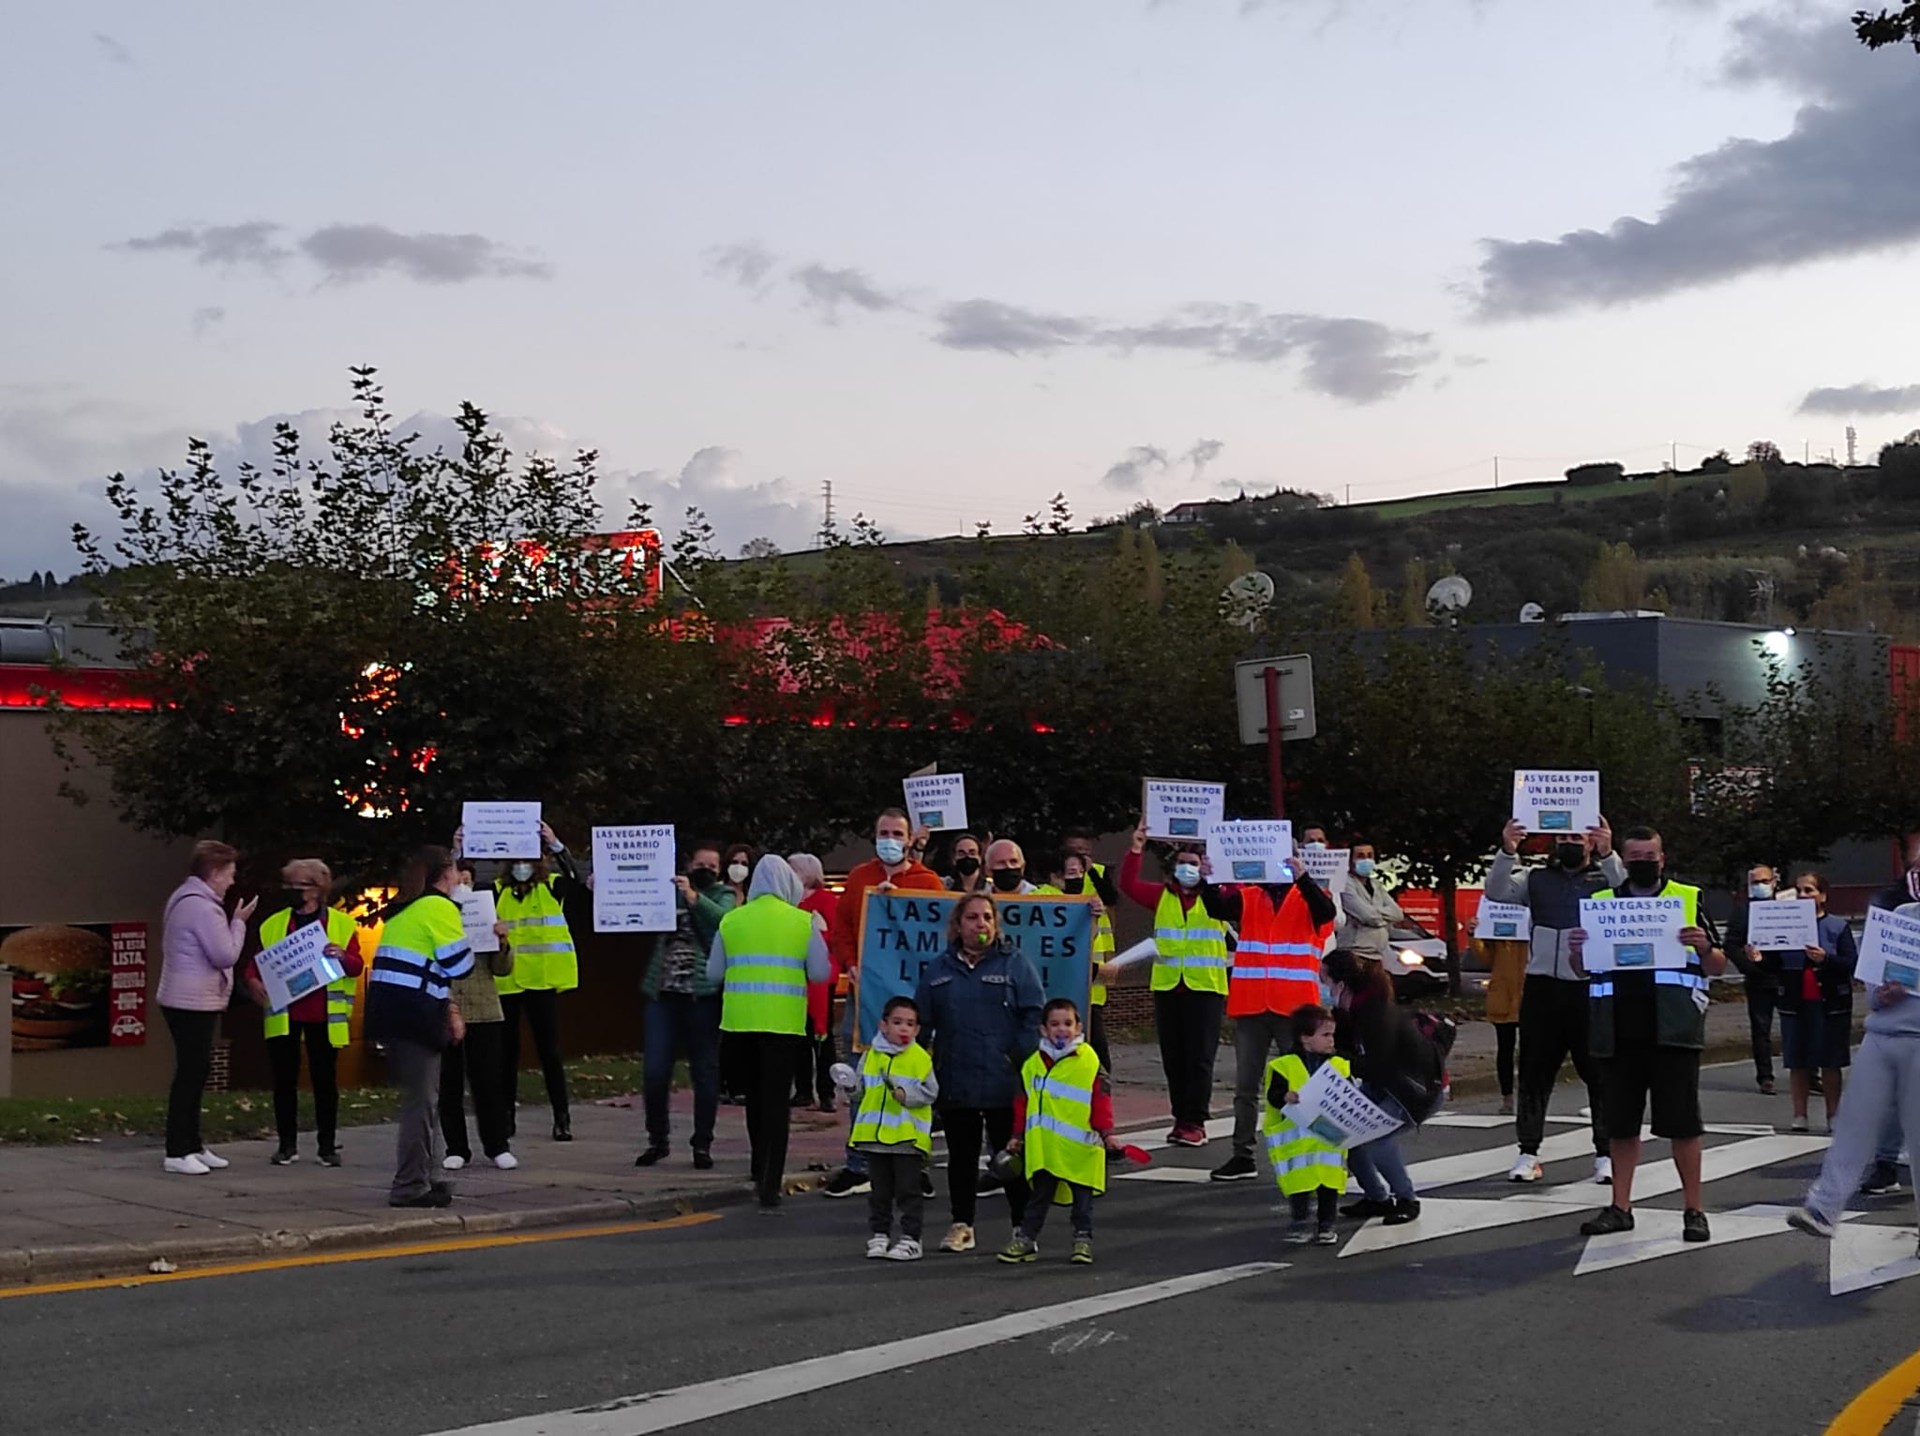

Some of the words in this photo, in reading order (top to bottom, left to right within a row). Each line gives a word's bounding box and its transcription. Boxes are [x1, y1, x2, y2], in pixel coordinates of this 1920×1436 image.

[916, 779, 940, 787] VEGAS
[921, 788, 951, 797] BARRIO
[1150, 784, 1167, 792] LAS
[1169, 785, 1200, 793] VEGAS
[1202, 787, 1221, 795] POR
[1176, 796, 1210, 805] BARRIO
[596, 830, 613, 839] LAS
[616, 830, 647, 838] VEGAS
[651, 829, 671, 837] POR
[1210, 826, 1226, 834] LAS
[1229, 825, 1264, 833] VEGAS
[623, 841, 660, 849] BARRIO
[1220, 837, 1234, 845] UN
[1237, 836, 1277, 844] BARRIO
[1584, 902, 1606, 911] LAS
[1610, 901, 1652, 910] VEGAS
[1656, 900, 1681, 909] POR
[887, 900, 941, 923] LAS
[1598, 916, 1616, 924] UN
[1621, 914, 1667, 924] BARRIO
[1872, 912, 1891, 924] LAS
[1881, 929, 1894, 940] UN
[258, 952, 272, 965] LAS
[272, 936, 300, 954] VEGAS
[301, 925, 320, 939] POR
[1041, 936, 1076, 958] ES
[282, 941, 314, 961] BARRIO
[1323, 1068, 1342, 1087] LAS
[1343, 1086, 1375, 1115] VEGAS
[1375, 1114, 1398, 1127] POR
[1324, 1087, 1340, 1102] UN
[1340, 1101, 1379, 1130] BARRIO
